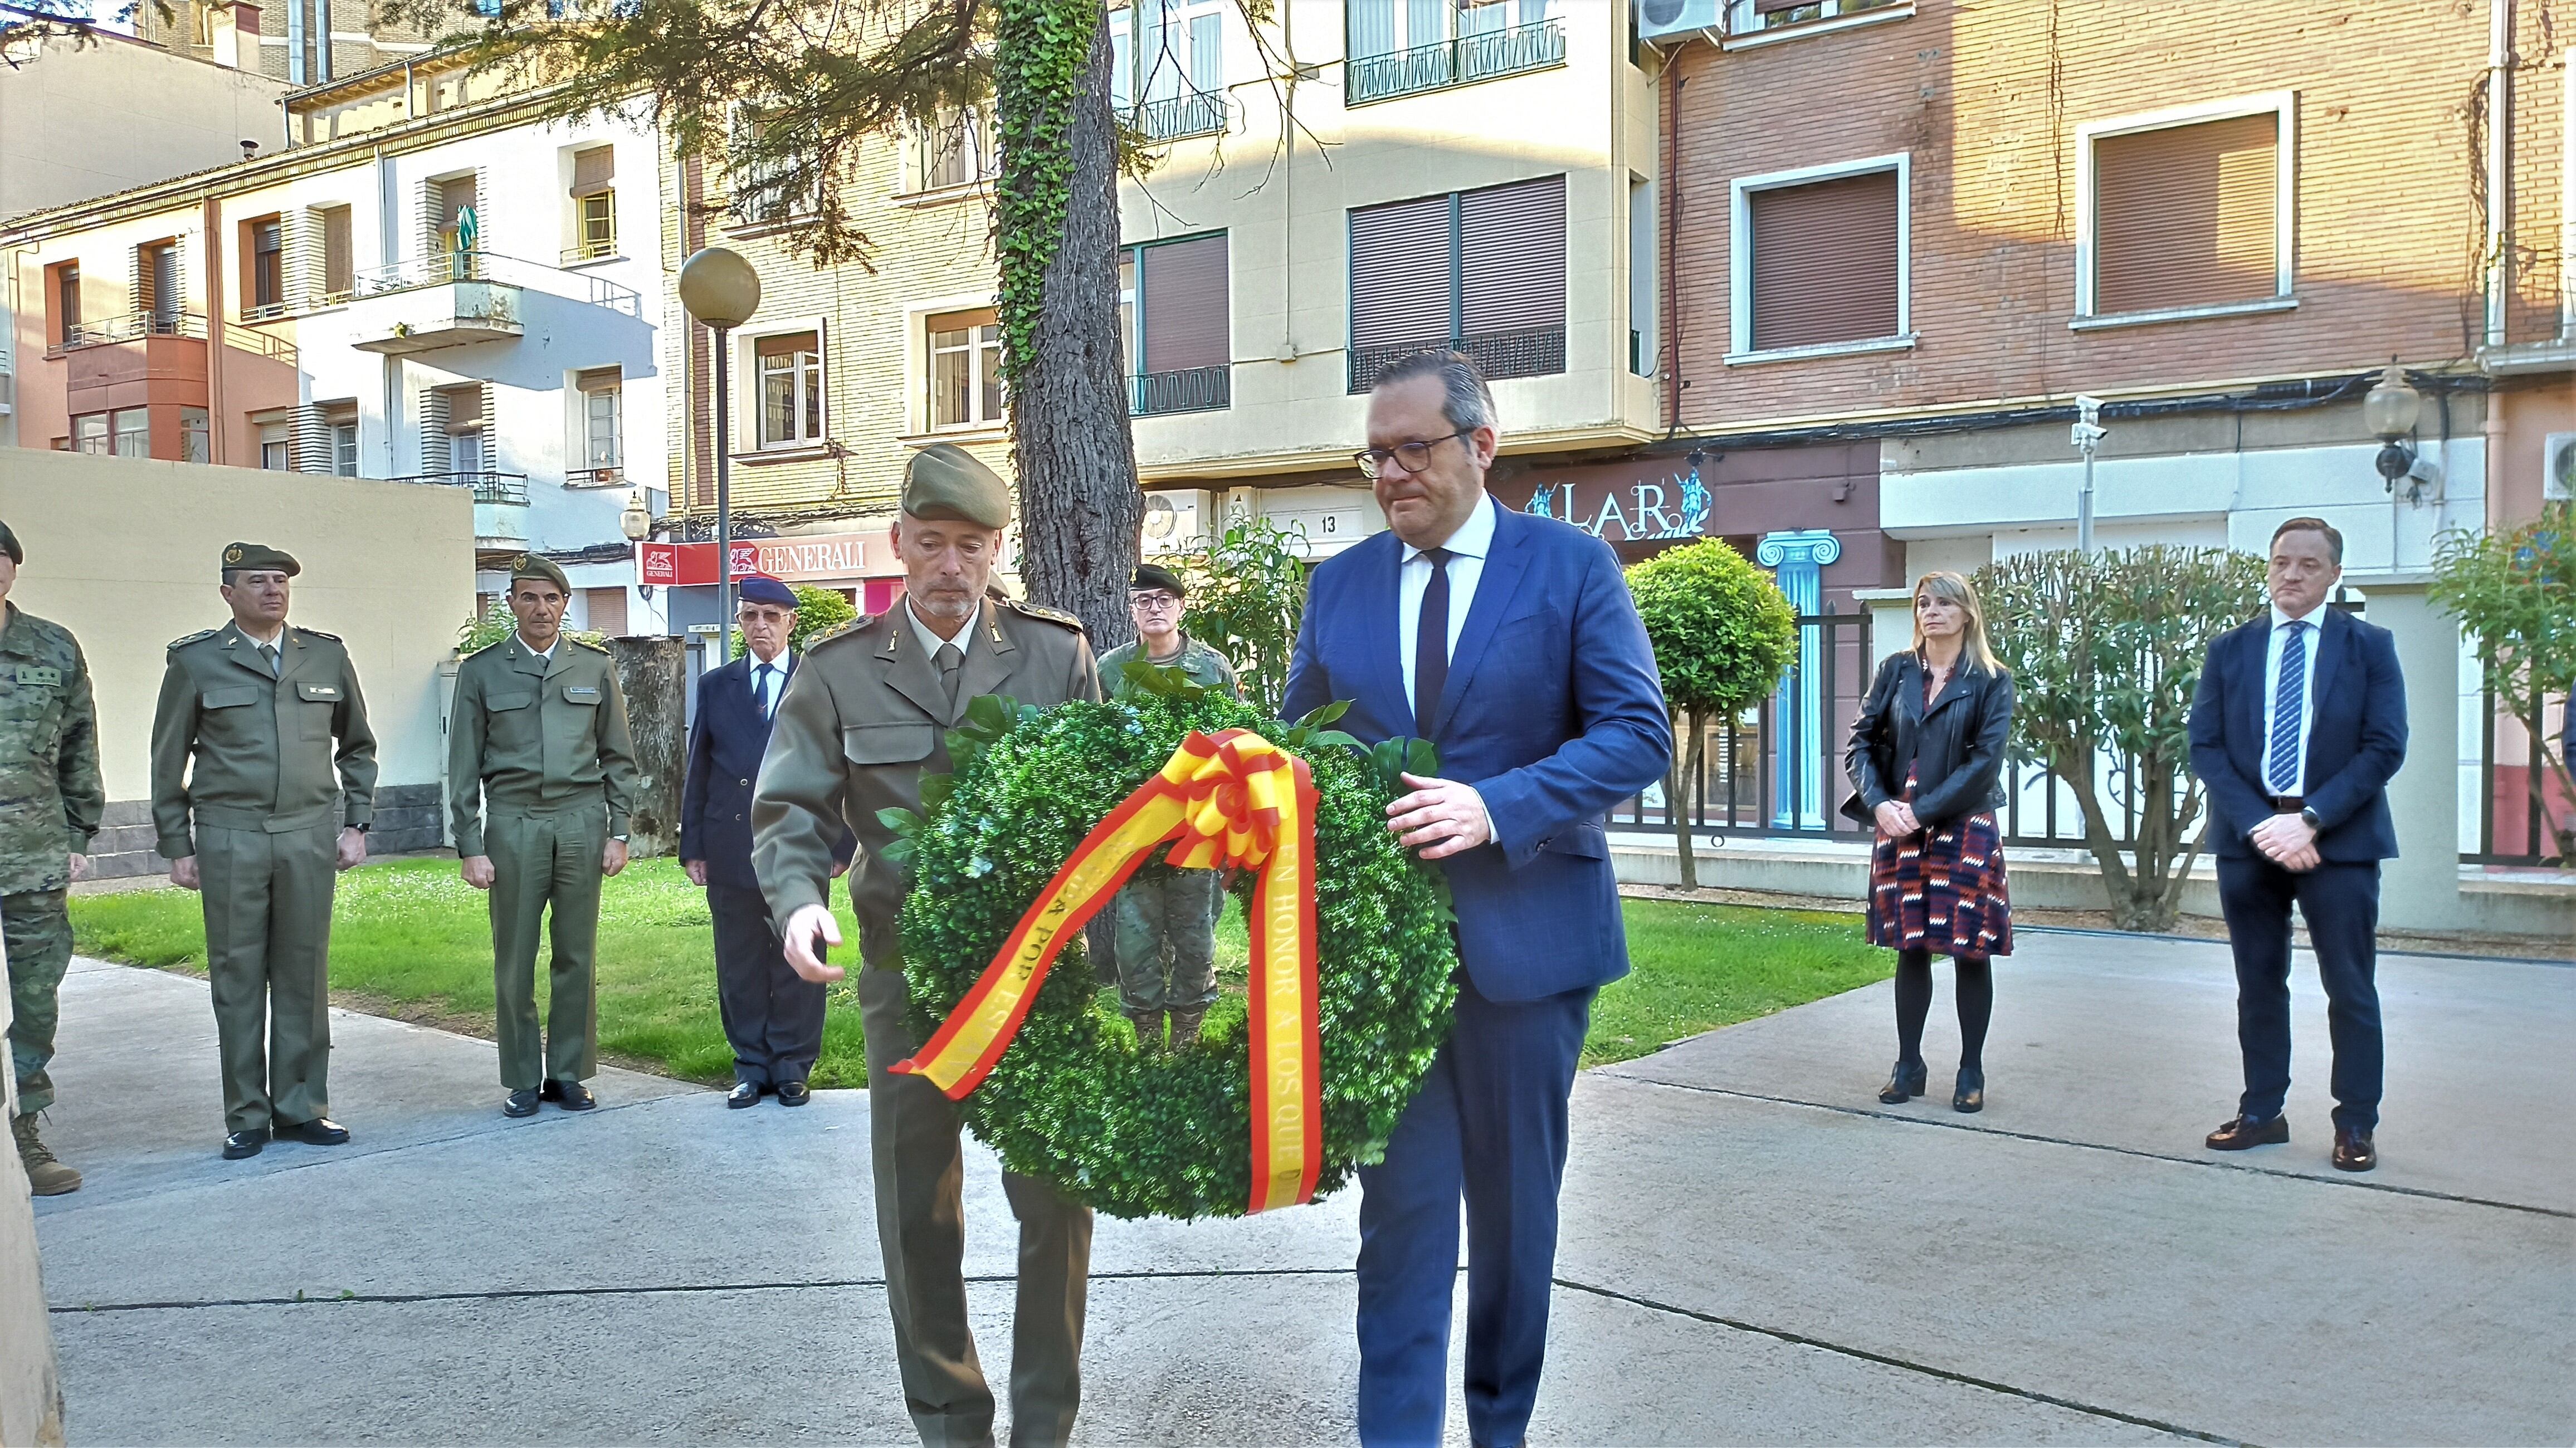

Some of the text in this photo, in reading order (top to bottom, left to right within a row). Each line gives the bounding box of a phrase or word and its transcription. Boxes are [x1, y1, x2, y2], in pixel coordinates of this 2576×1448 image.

[1322, 516, 1335, 533] 13
[1562, 483, 1670, 541] LAR
[758, 541, 866, 574] GENERALI
[1274, 844, 1297, 882] EN
[1008, 926, 1053, 981] POR
[1272, 893, 1297, 995] HONOR
[1275, 1010, 1298, 1030] A
[1276, 1042, 1300, 1095] LOS
[1274, 1103, 1302, 1161] QUE
